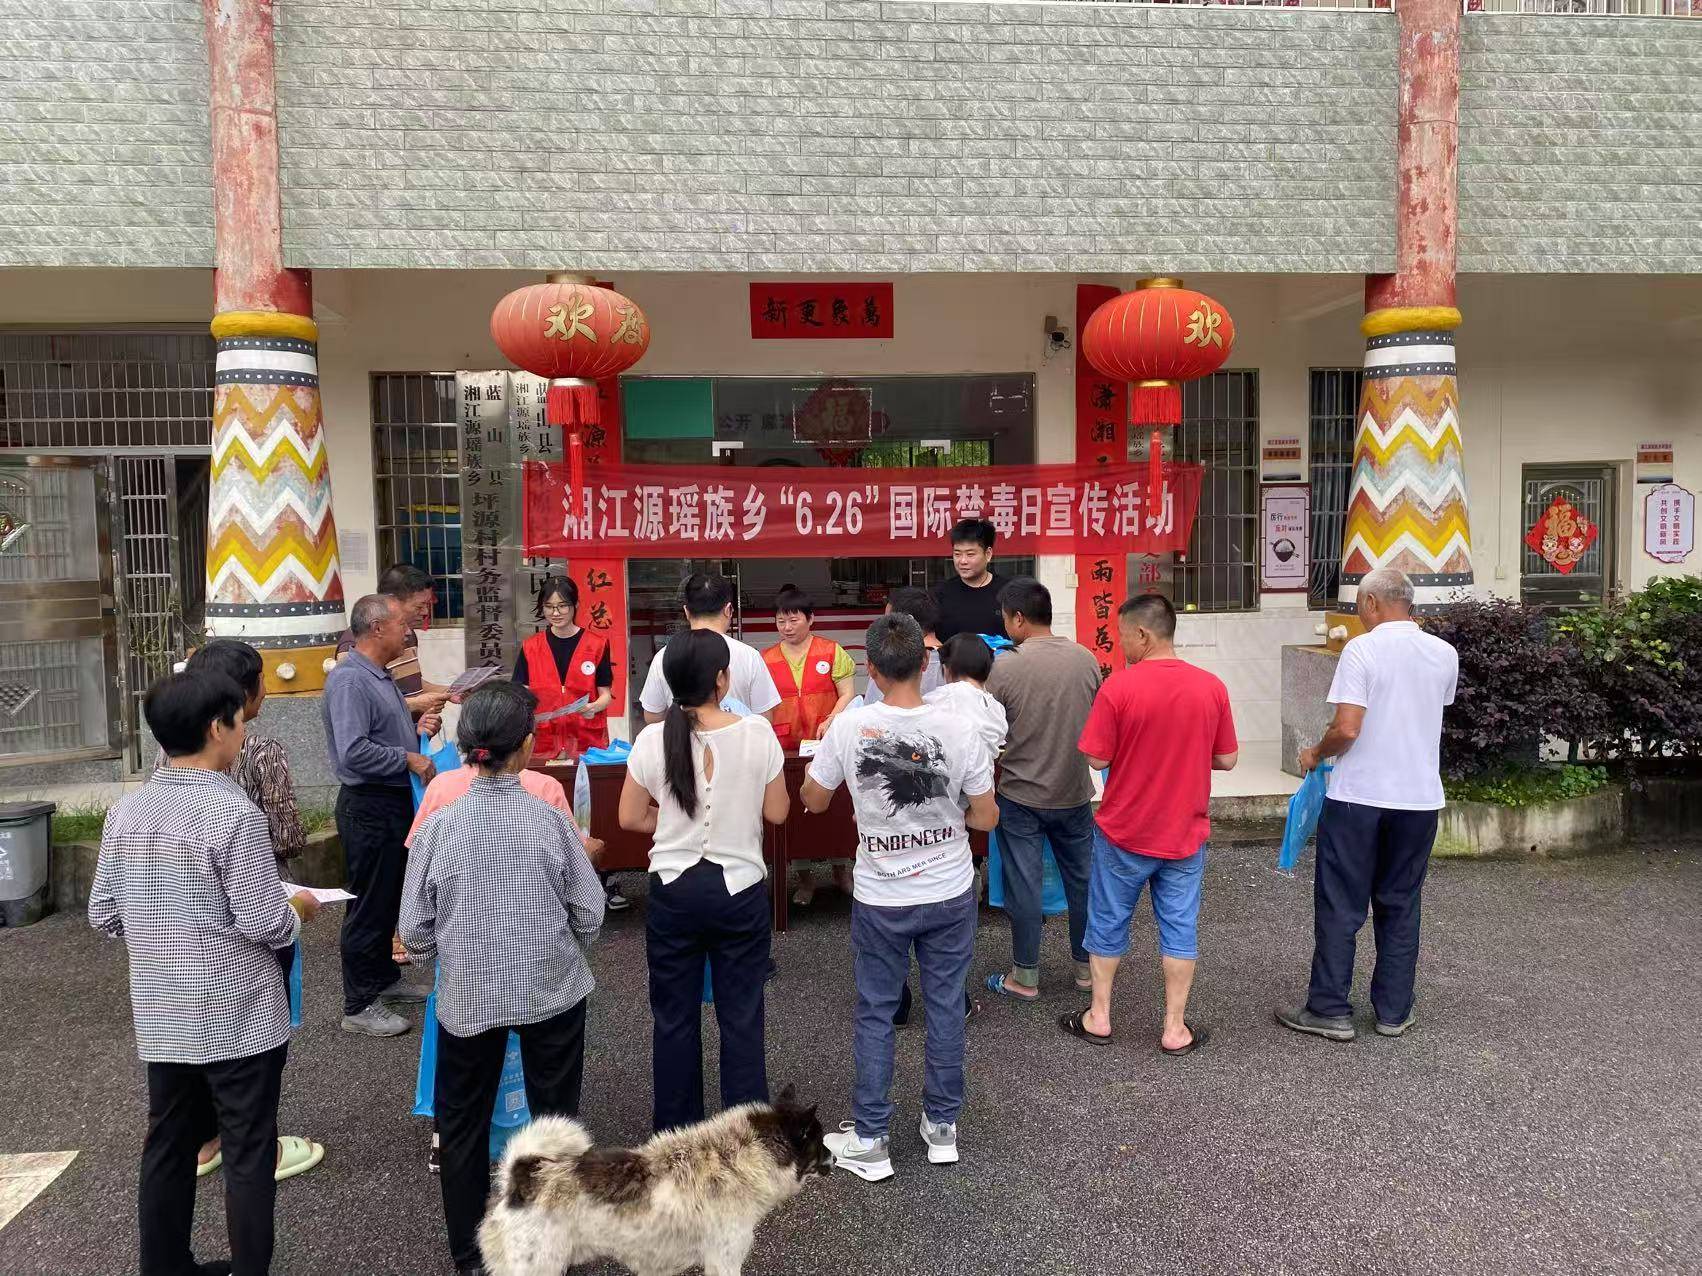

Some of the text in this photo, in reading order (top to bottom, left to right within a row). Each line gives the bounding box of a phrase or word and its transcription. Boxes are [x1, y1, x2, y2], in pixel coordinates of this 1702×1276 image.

[464, 385, 482, 486] 湘江源瑶族乡
[485, 385, 504, 486] 蓝山县
[516, 383, 531, 454] 湘江源瑶族乡
[1543, 504, 1577, 537] 福
[927, 853, 946, 863] SINCE
